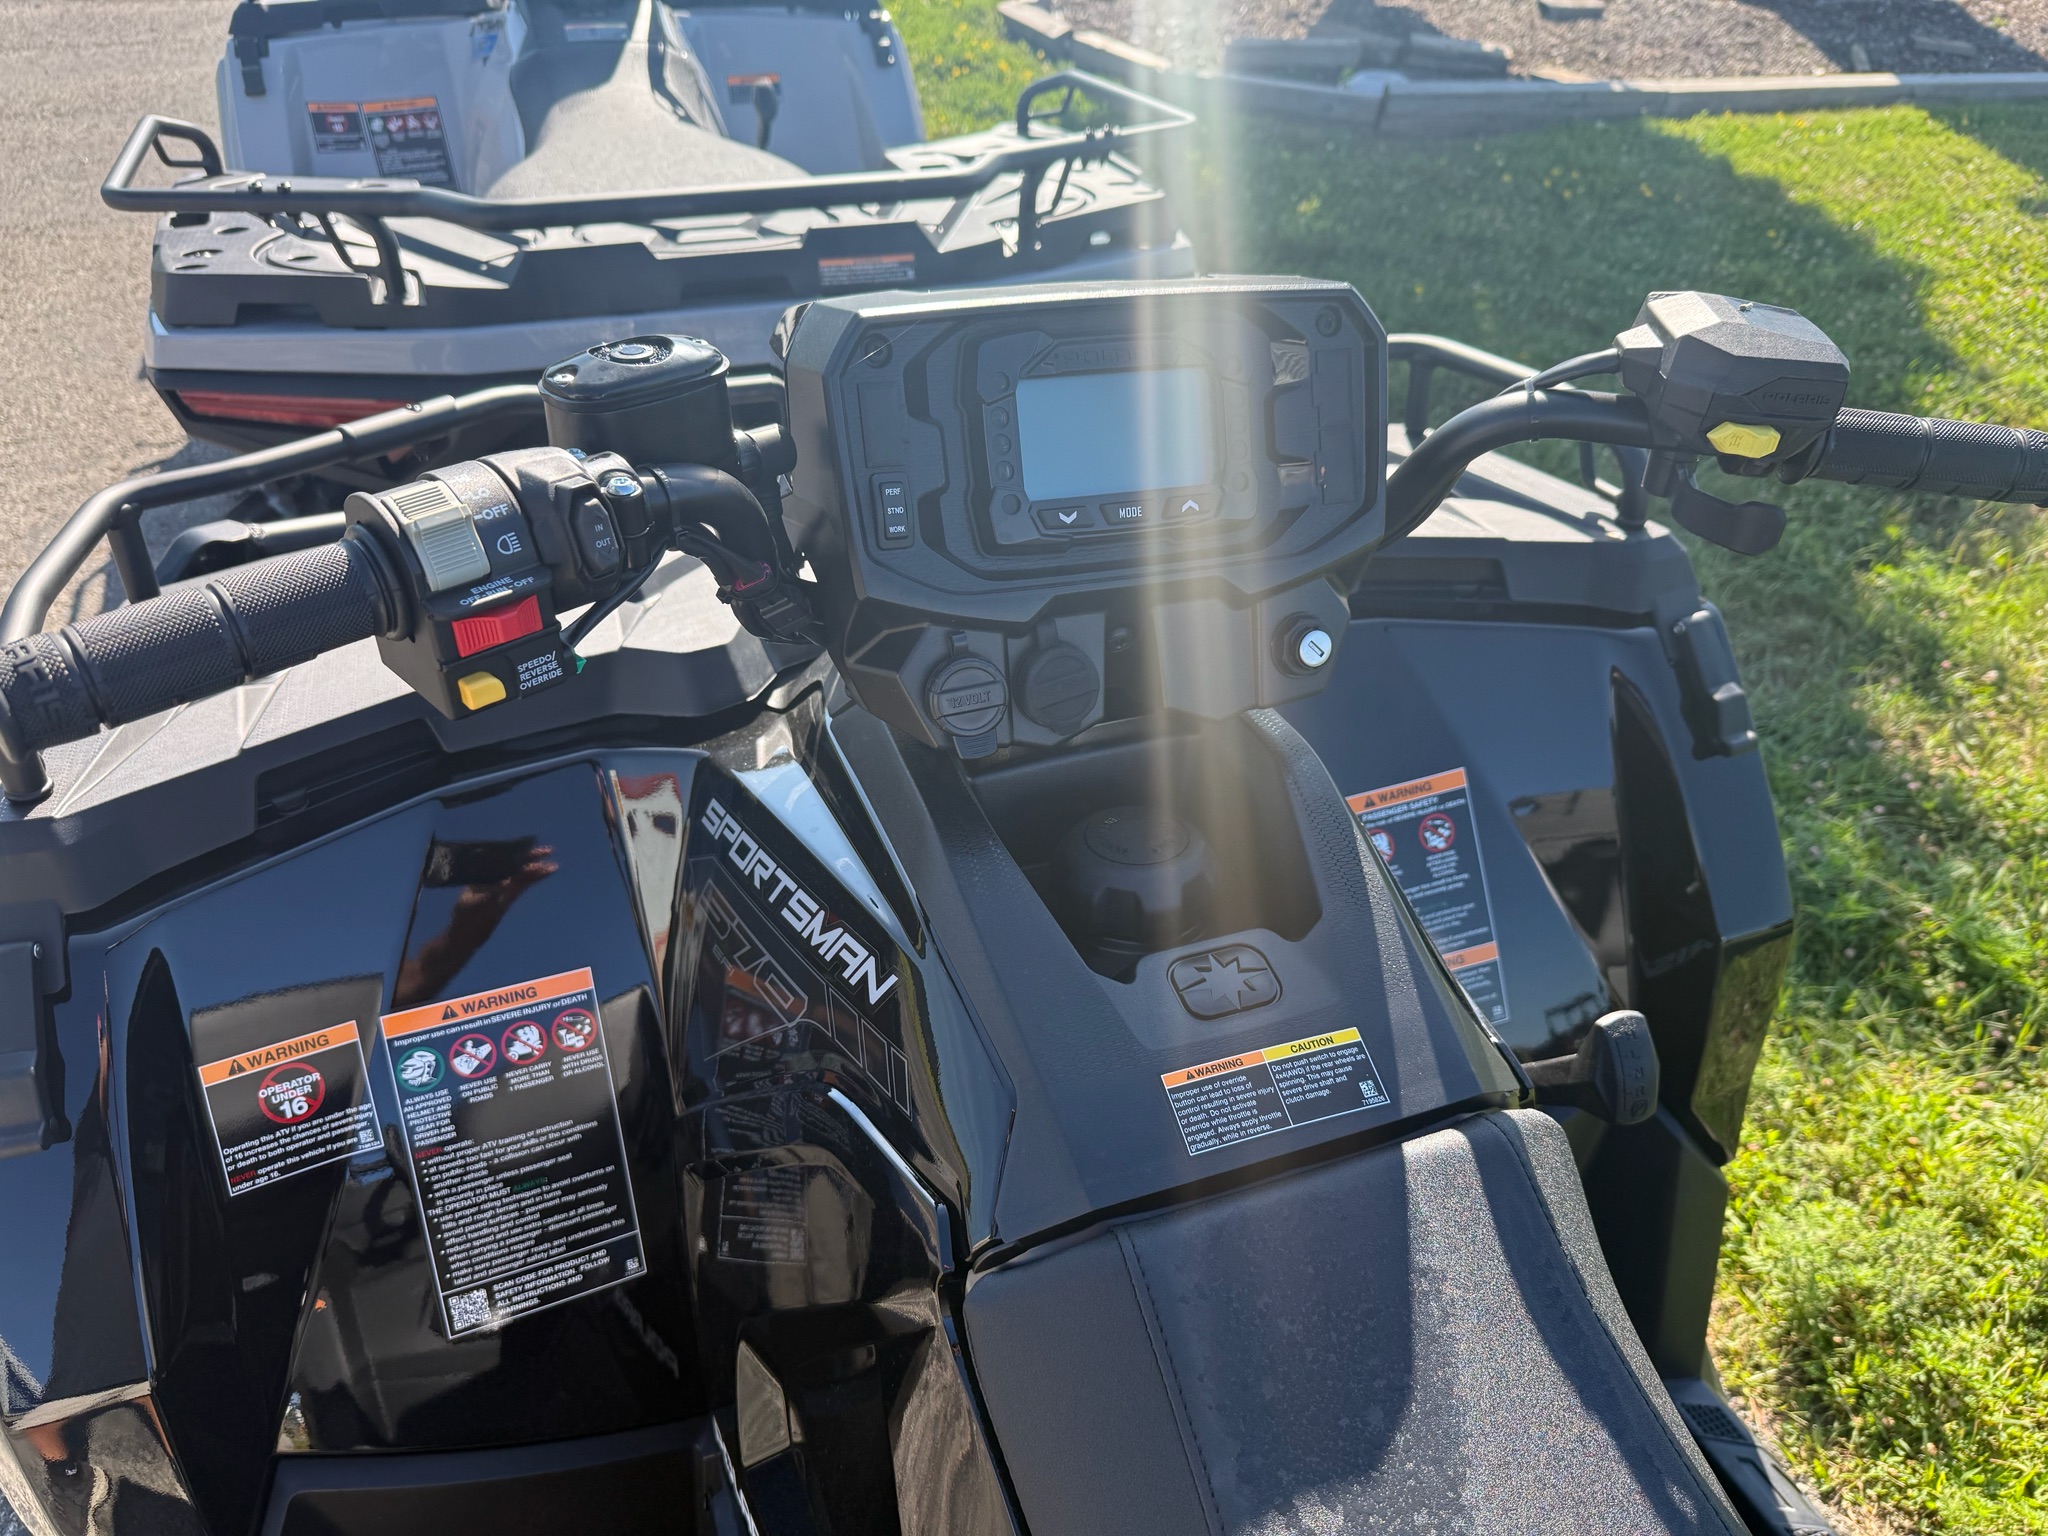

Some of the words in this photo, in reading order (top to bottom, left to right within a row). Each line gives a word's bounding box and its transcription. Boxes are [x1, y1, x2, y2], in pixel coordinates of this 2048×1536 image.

[885, 488, 901, 496] PERF
[887, 507, 904, 515] STND
[1119, 506, 1143, 519] MODE
[594, 523, 604, 532] IN
[889, 525, 906, 533] WORK
[596, 537, 611, 548] OUT
[470, 576, 514, 595] ENGINE
[517, 650, 556, 673] SPEEDO/
[519, 660, 559, 682] REVERSE
[520, 667, 563, 690] OVERRIDE
[951, 695, 963, 709] 12
[964, 689, 992, 706] VOLT
[1378, 782, 1432, 803] WARNING
[1361, 804, 1408, 821] PASSENGER
[1408, 796, 1439, 812] SAFETY
[701, 798, 899, 1005] SPORTSMAN
[461, 987, 537, 1013] WARNING
[394, 1033, 430, 1046] Improper
[430, 1030, 445, 1038] use
[445, 1026, 460, 1034] can
[460, 1020, 482, 1030] result
[490, 1010, 522, 1022] SEVERE
[522, 1002, 551, 1015] INJURY
[560, 993, 587, 1005] DEATH
[246, 1034, 329, 1067] WARNING
[1290, 1036, 1334, 1053] CAUTION
[1194, 1058, 1243, 1076] WARNING
[1275, 1067, 1305, 1079] 4x4(AWD)
[1334, 1055, 1355, 1065] wheels
[1281, 1061, 1293, 1069] not
[1292, 1058, 1308, 1067] push
[1308, 1053, 1329, 1062] switch
[1336, 1047, 1358, 1056] engage
[258, 1072, 321, 1098] OPERATOR
[459, 1081, 482, 1090] NEVER
[483, 1076, 496, 1084] USE
[1170, 1088, 1199, 1099] Improper
[1221, 1075, 1246, 1086] override
[1278, 1077, 1306, 1088] spinning.
[1334, 1065, 1352, 1073] cause
[1281, 1086, 1302, 1096] severe
[1303, 1082, 1318, 1090] drive
[1319, 1078, 1334, 1086] shaft
[1335, 1074, 1347, 1082] and
[271, 1085, 311, 1103] UNDER
[469, 1092, 493, 1102] ROADS
[474, 1084, 498, 1094] PUBLIC
[1174, 1098, 1195, 1108] button
[1196, 1094, 1208, 1102] can
[1208, 1089, 1223, 1098] lead
[1285, 1095, 1304, 1104] clutch
[1304, 1088, 1331, 1099] damage.
[279, 1096, 310, 1120] 16
[1177, 1104, 1200, 1116] control
[1200, 1098, 1228, 1109] resulting
[1235, 1091, 1256, 1100] severe
[1256, 1086, 1274, 1095] injury
[1188, 1112, 1209, 1122] death.
[1220, 1106, 1231, 1114] not
[1232, 1100, 1256, 1110] activate
[223, 1139, 259, 1155] Operating
[260, 1134, 274, 1142] this
[275, 1127, 289, 1137] ATV
[297, 1122, 311, 1131] you
[324, 1111, 344, 1121] under
[1184, 1121, 1210, 1133] override
[1210, 1116, 1227, 1126] while
[1227, 1110, 1251, 1120] throttle
[1187, 1128, 1216, 1142] engaged.
[1218, 1122, 1240, 1133] Always
[1241, 1118, 1258, 1127] apply
[1258, 1111, 1281, 1121] throttle
[225, 1155, 232, 1163] of
[244, 1141, 278, 1156] increases
[292, 1127, 321, 1140] chances
[330, 1116, 353, 1127] severe
[354, 1111, 373, 1120] injury
[236, 1156, 257, 1168] death
[267, 1147, 284, 1157] both
[285, 1137, 315, 1151] operator
[317, 1131, 330, 1140] and
[331, 1120, 369, 1136] passenger.
[1190, 1138, 1221, 1151] gradually,
[1221, 1132, 1238, 1141] while
[1246, 1124, 1272, 1134] reverse.
[230, 1170, 256, 1183] NEVER
[257, 1161, 285, 1174] operate
[286, 1156, 300, 1164] this
[300, 1147, 325, 1159] vehicle
[332, 1141, 345, 1150] you
[232, 1180, 253, 1192] under
[255, 1175, 268, 1184] age
[270, 1171, 281, 1180] 16.
[493, 1279, 514, 1290] SCAN
[515, 1272, 536, 1283] CODE
[538, 1267, 553, 1276] FOR
[554, 1255, 588, 1270] PRODUCT
[591, 1249, 606, 1259] AND
[495, 1285, 522, 1299] SAFETY
[524, 1268, 575, 1289] INFORMATION.
[580, 1256, 609, 1270] FOLLOW
[496, 1298, 510, 1307] ALL
[512, 1280, 566, 1302] INSTRUCTIONS
[567, 1274, 582, 1284] AND
